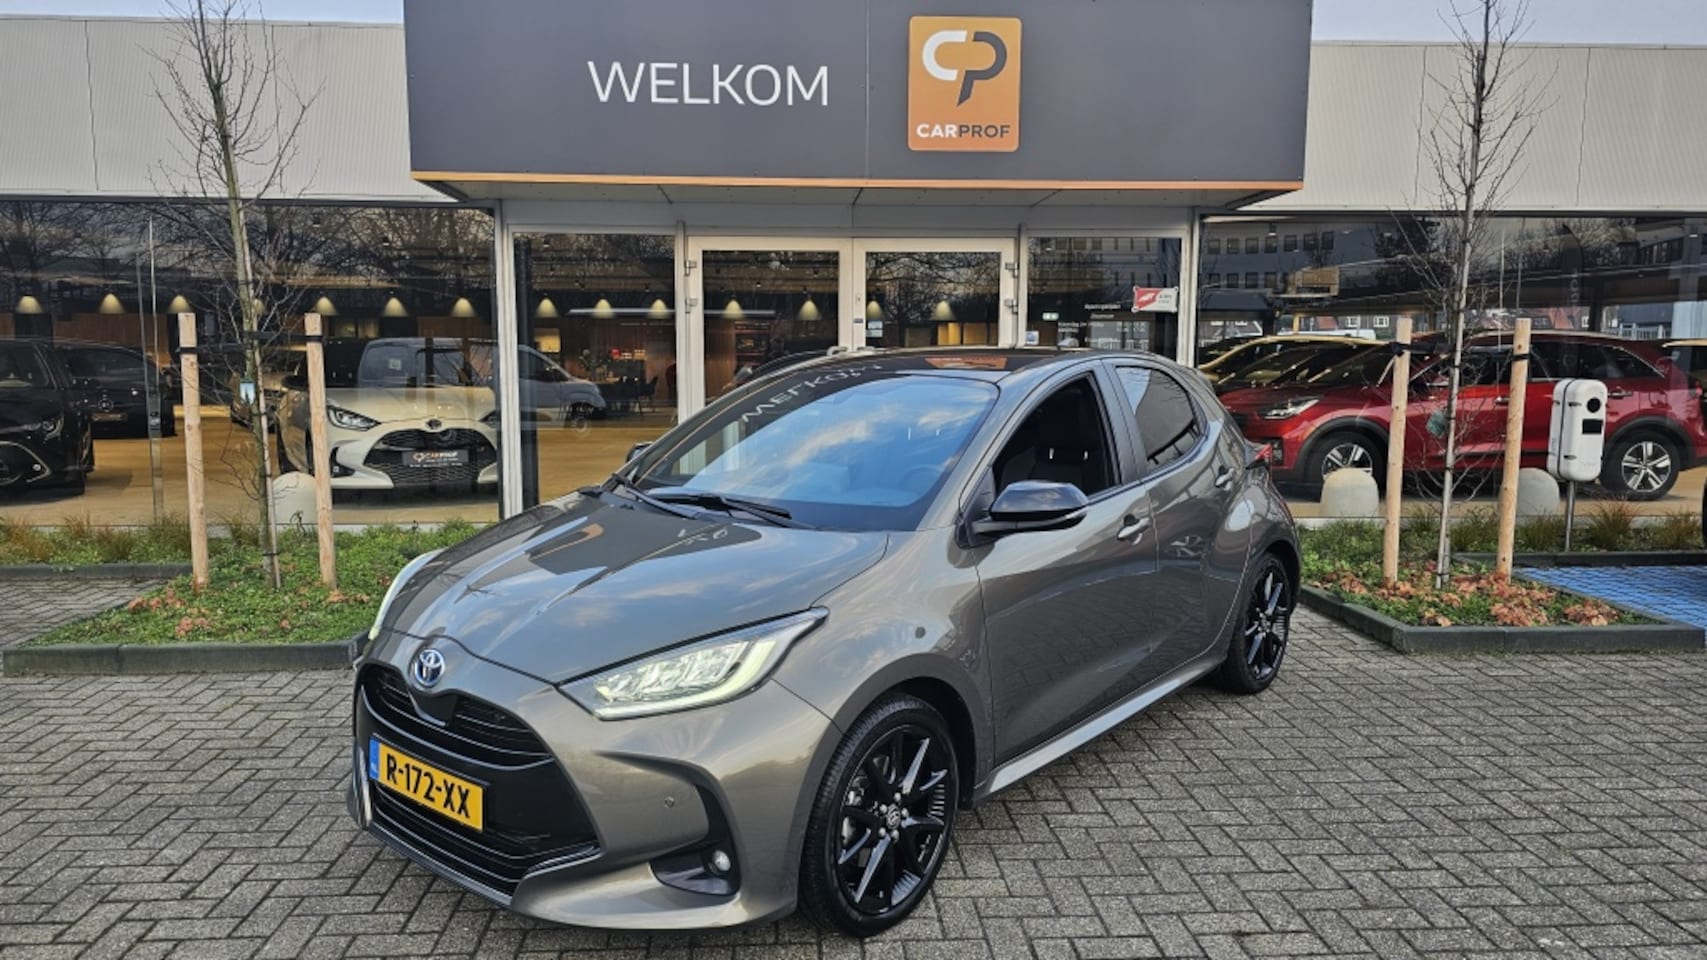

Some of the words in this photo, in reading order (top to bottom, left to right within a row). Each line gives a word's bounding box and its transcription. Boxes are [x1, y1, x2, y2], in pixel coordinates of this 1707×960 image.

[587, 61, 828, 106] WELKOM
[916, 123, 1011, 138] CARPROF
[387, 753, 470, 819] R-172-XX
